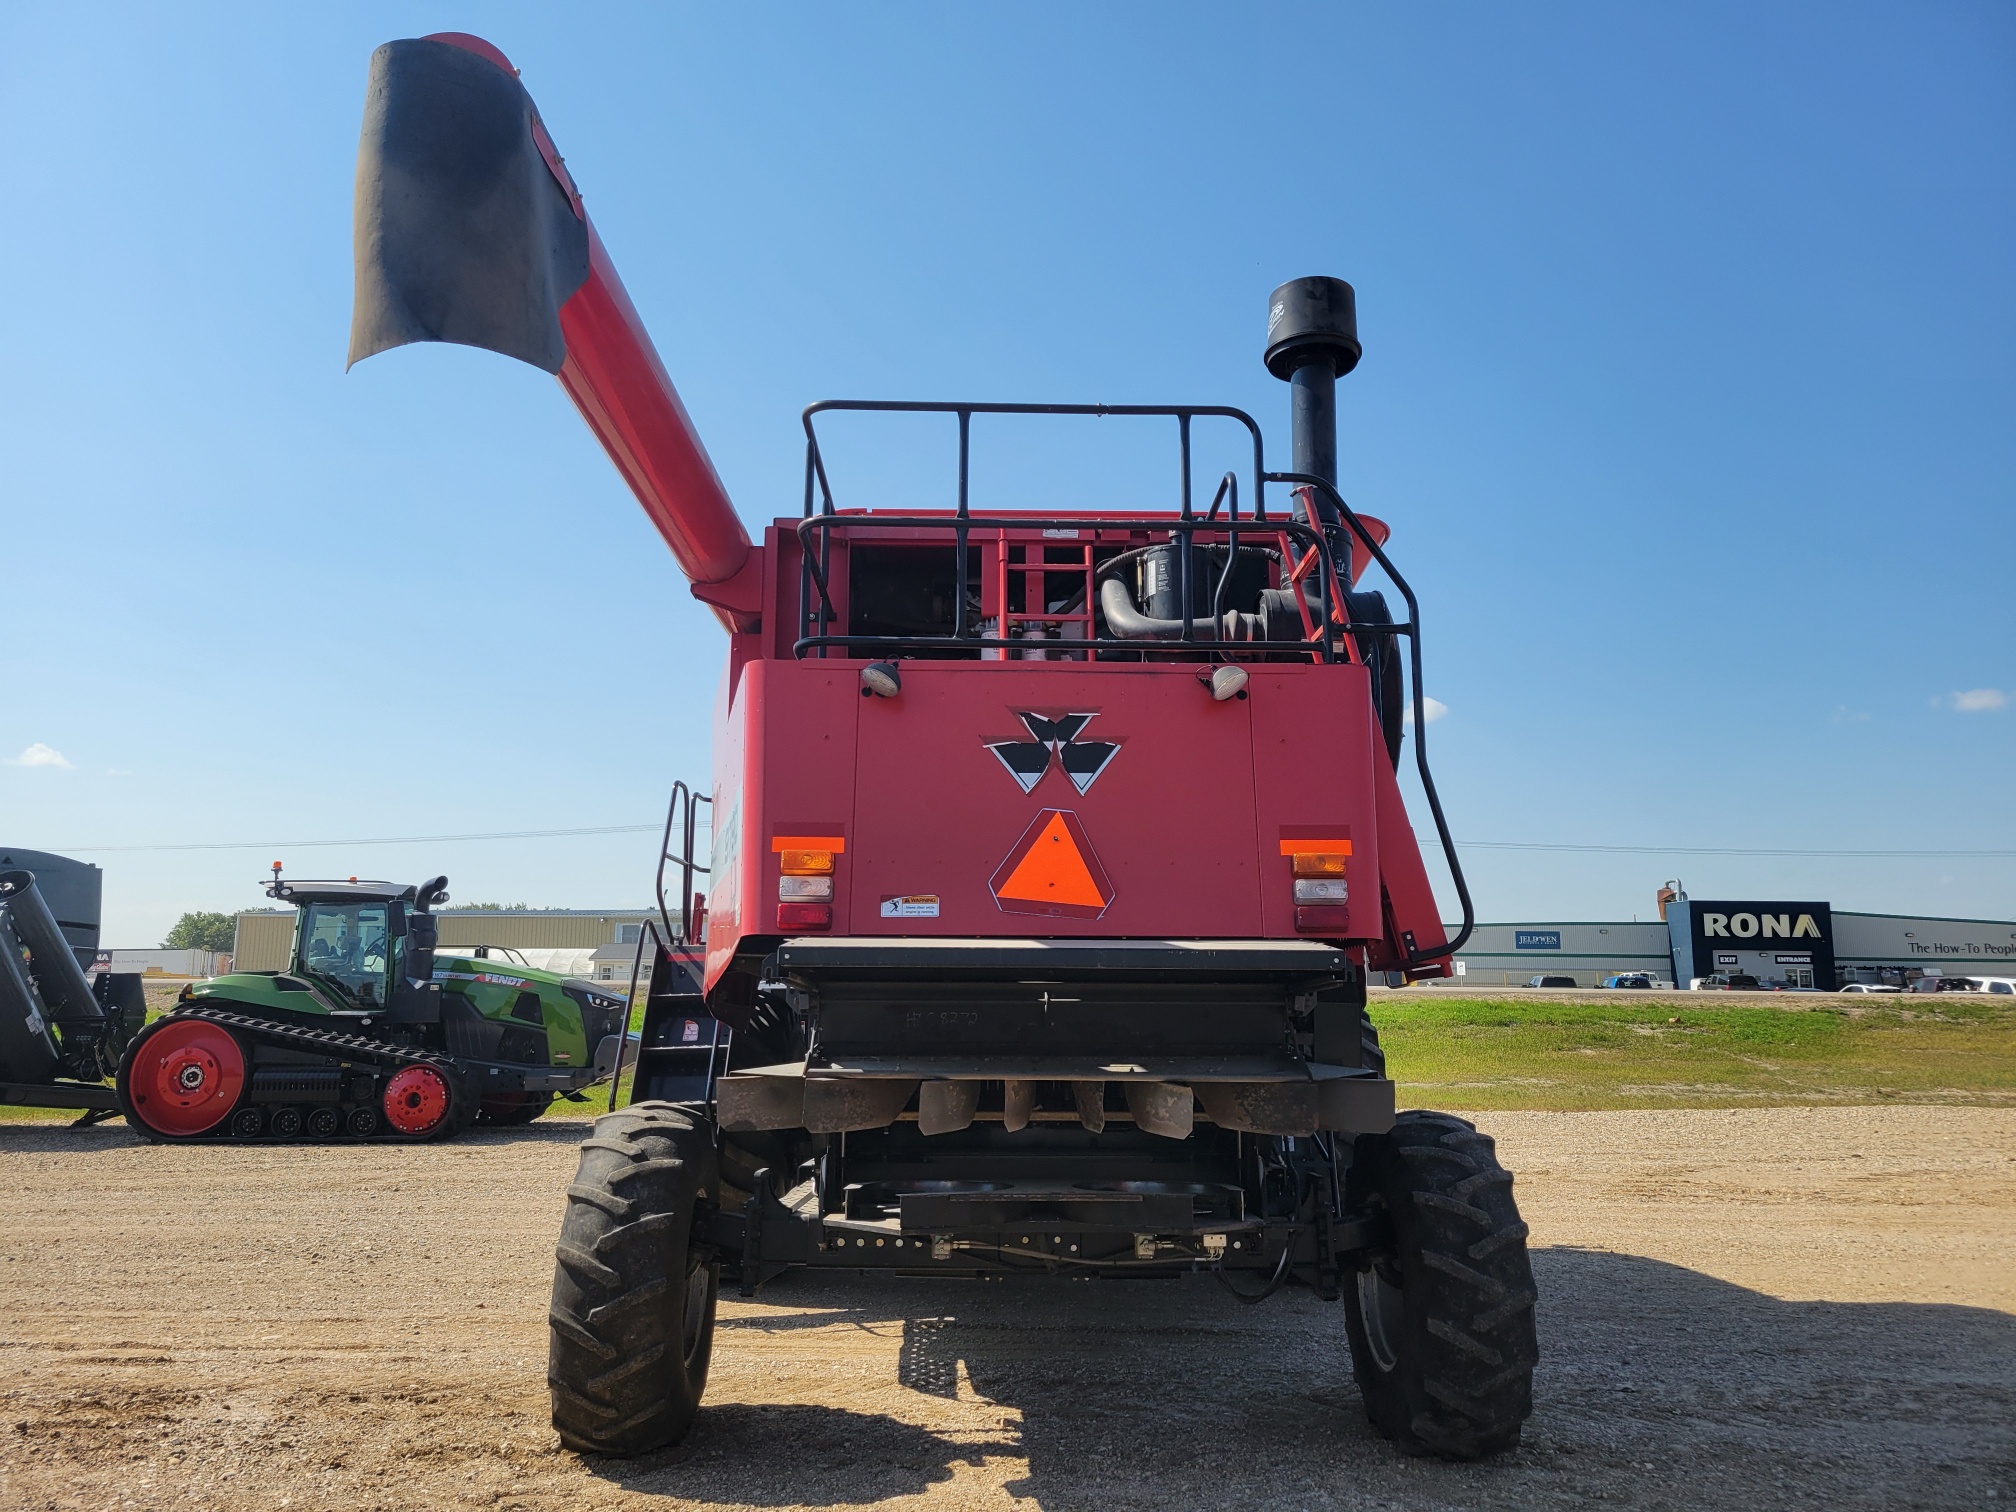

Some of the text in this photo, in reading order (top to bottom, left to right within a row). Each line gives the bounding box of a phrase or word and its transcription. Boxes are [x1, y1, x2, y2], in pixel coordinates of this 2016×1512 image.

[1703, 913, 1821, 938] RONA
[1908, 942, 1930, 954] The
[1933, 942, 1980, 954] How-To
[485, 973, 526, 987] FENDT
